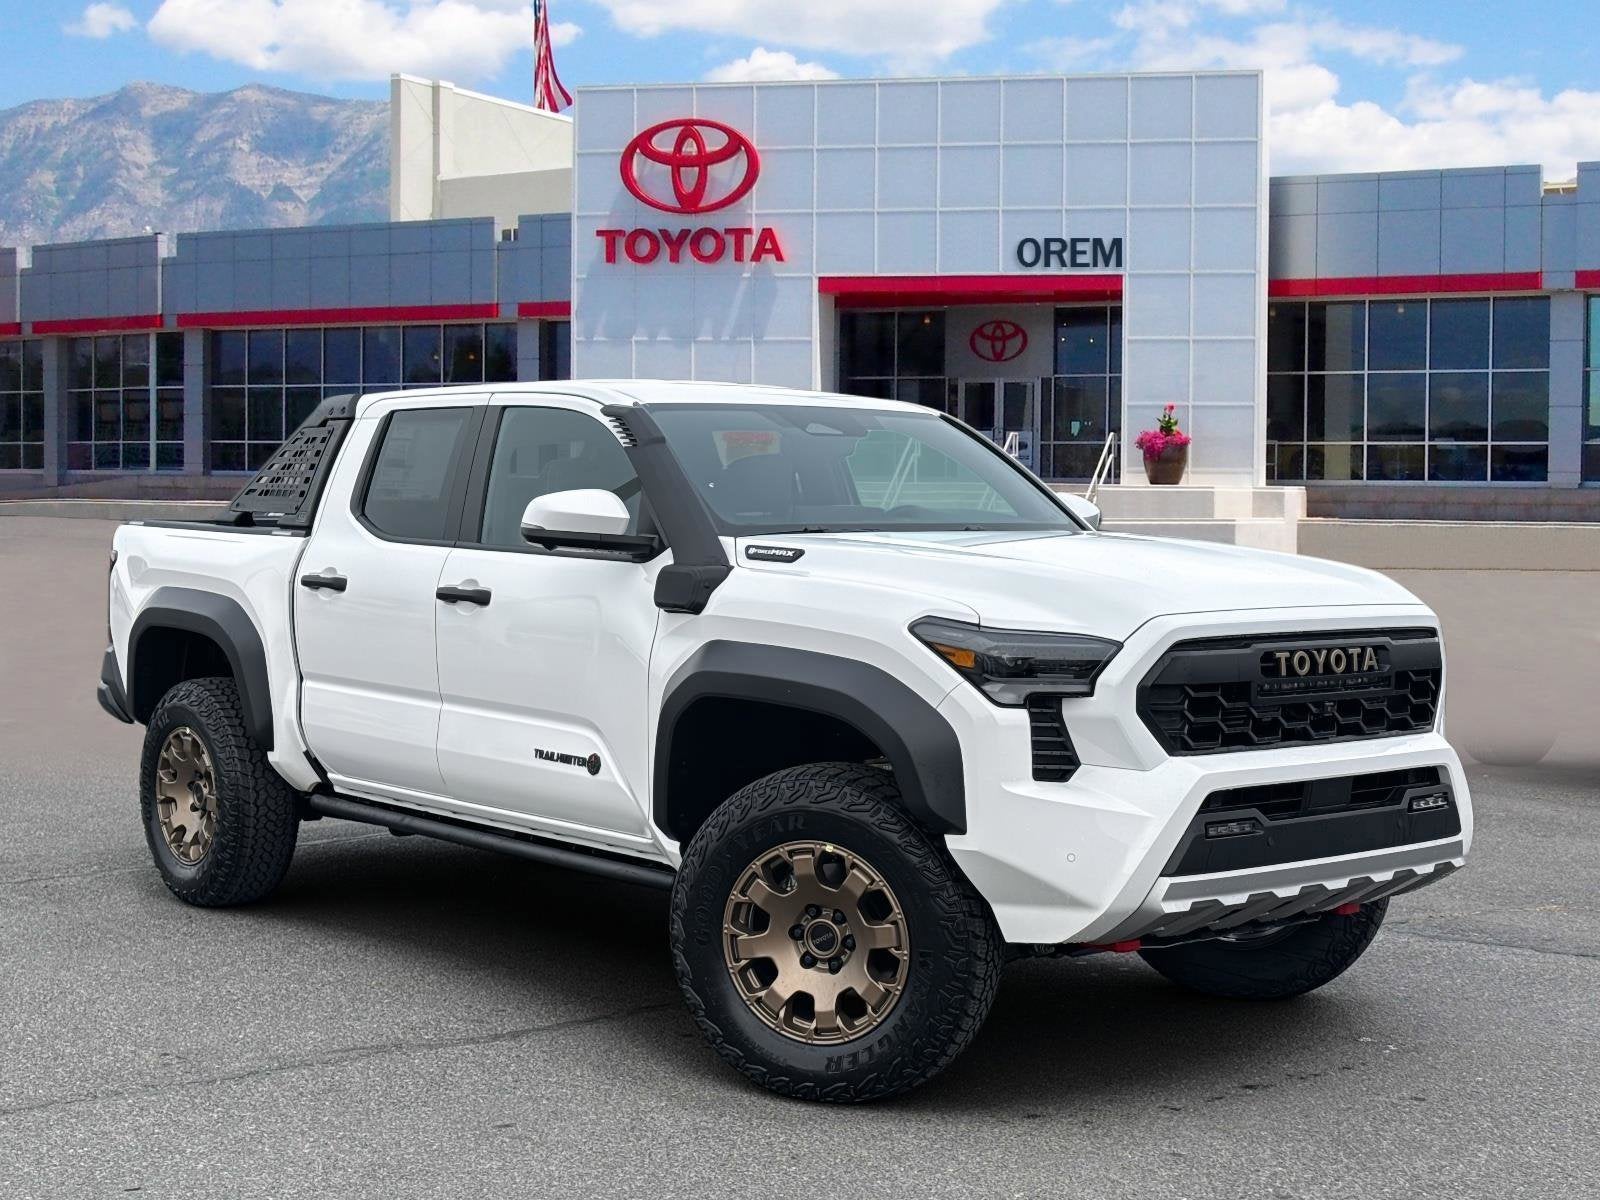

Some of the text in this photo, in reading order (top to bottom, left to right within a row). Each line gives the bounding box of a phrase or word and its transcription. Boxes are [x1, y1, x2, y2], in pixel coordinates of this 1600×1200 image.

[596, 227, 785, 263] TOYOTA
[1016, 237, 1123, 269] OREM
[1275, 647, 1379, 676] TOYOTA
